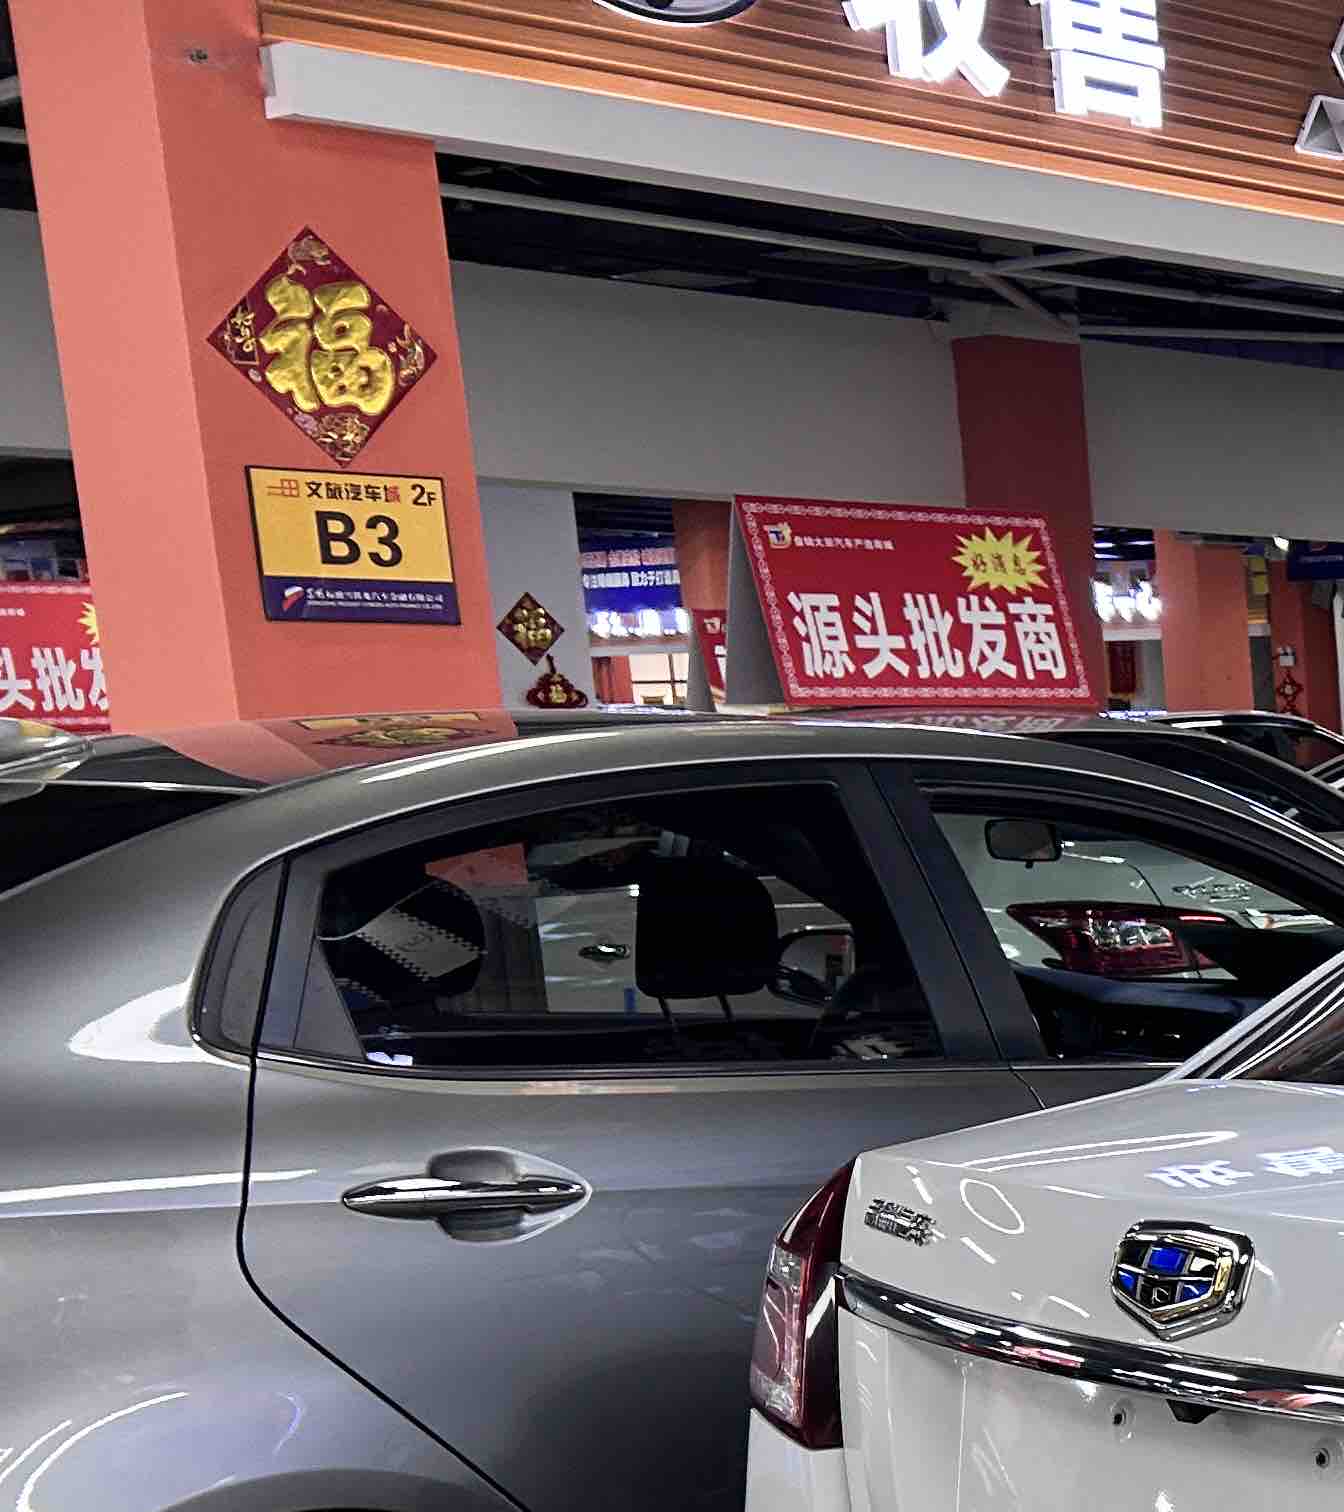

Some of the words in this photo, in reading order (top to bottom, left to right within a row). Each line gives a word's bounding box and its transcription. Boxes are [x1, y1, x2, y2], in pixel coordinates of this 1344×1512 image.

[259, 274, 395, 416] 福
[411, 483, 436, 506] 2F
[315, 510, 403, 568] B3
[787, 591, 1067, 680] 源头批发商
